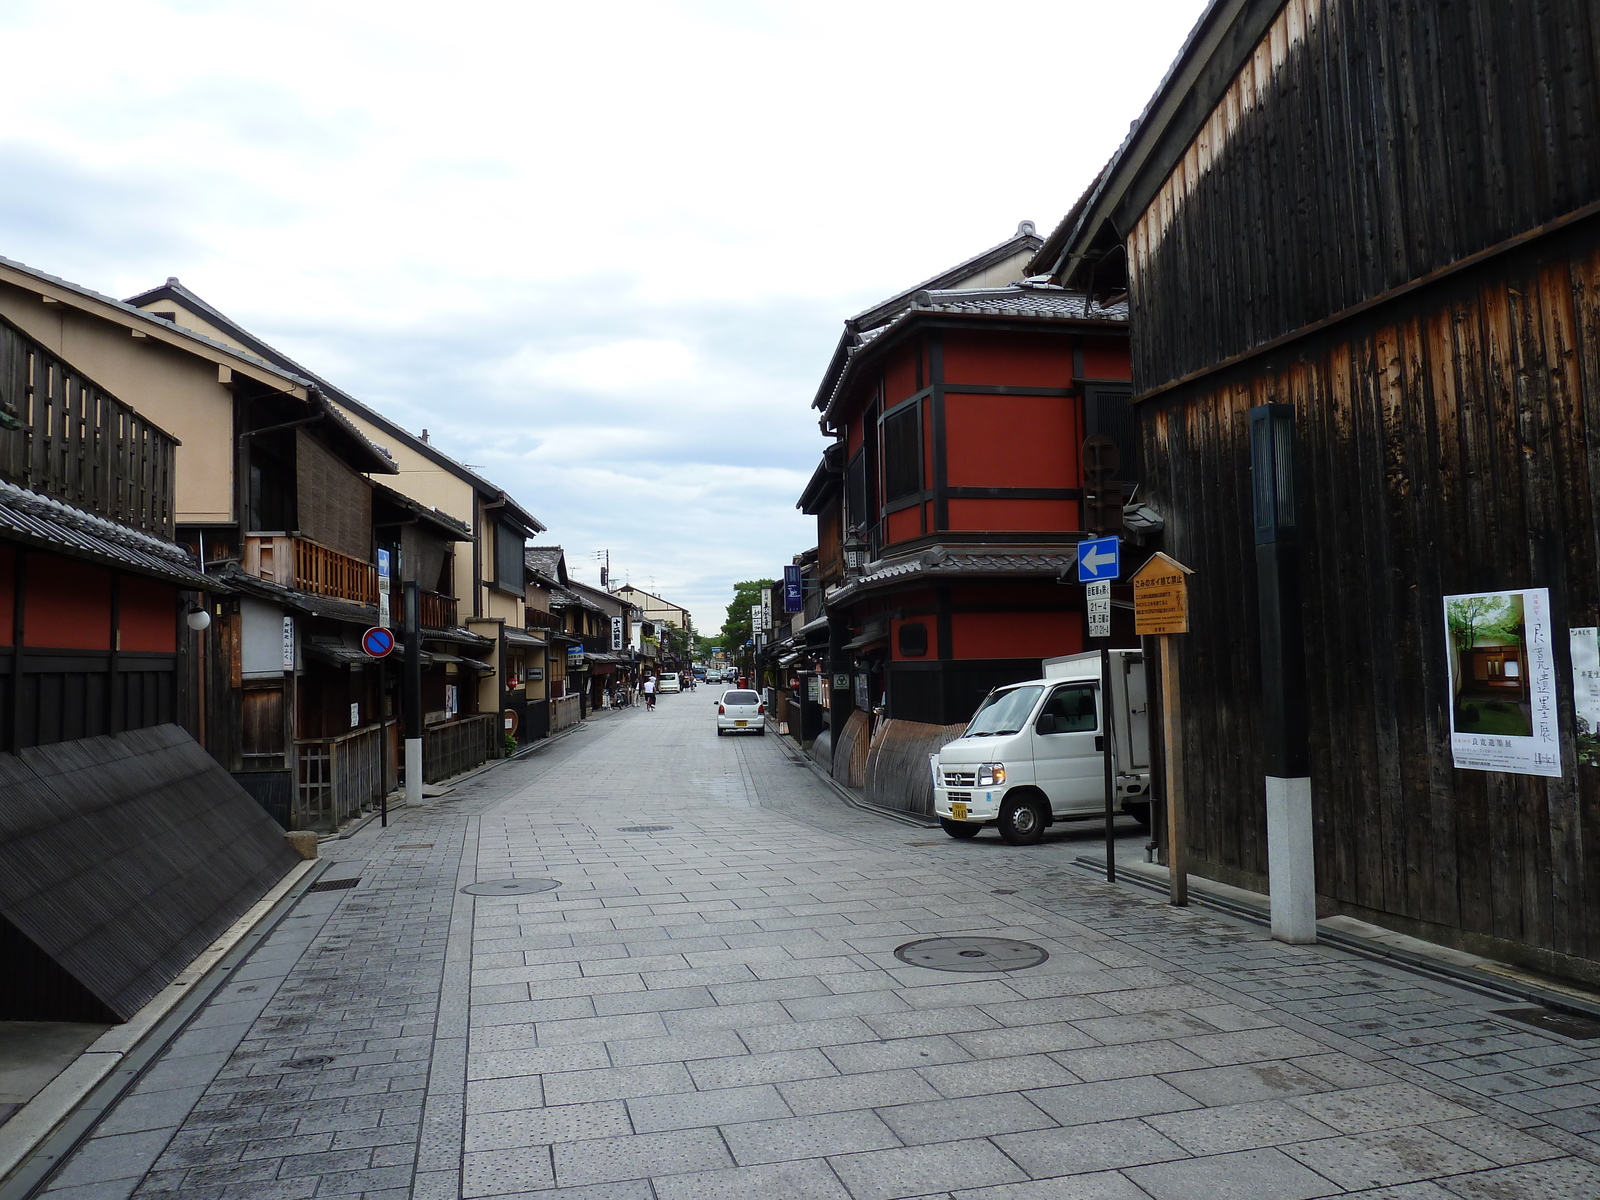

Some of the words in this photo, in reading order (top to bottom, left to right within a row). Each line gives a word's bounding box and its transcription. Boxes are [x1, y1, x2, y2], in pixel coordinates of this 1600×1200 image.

[1135, 576, 1182, 588] ごみのポイ捨て禁止
[1087, 585, 1109, 597] 自転車を除く
